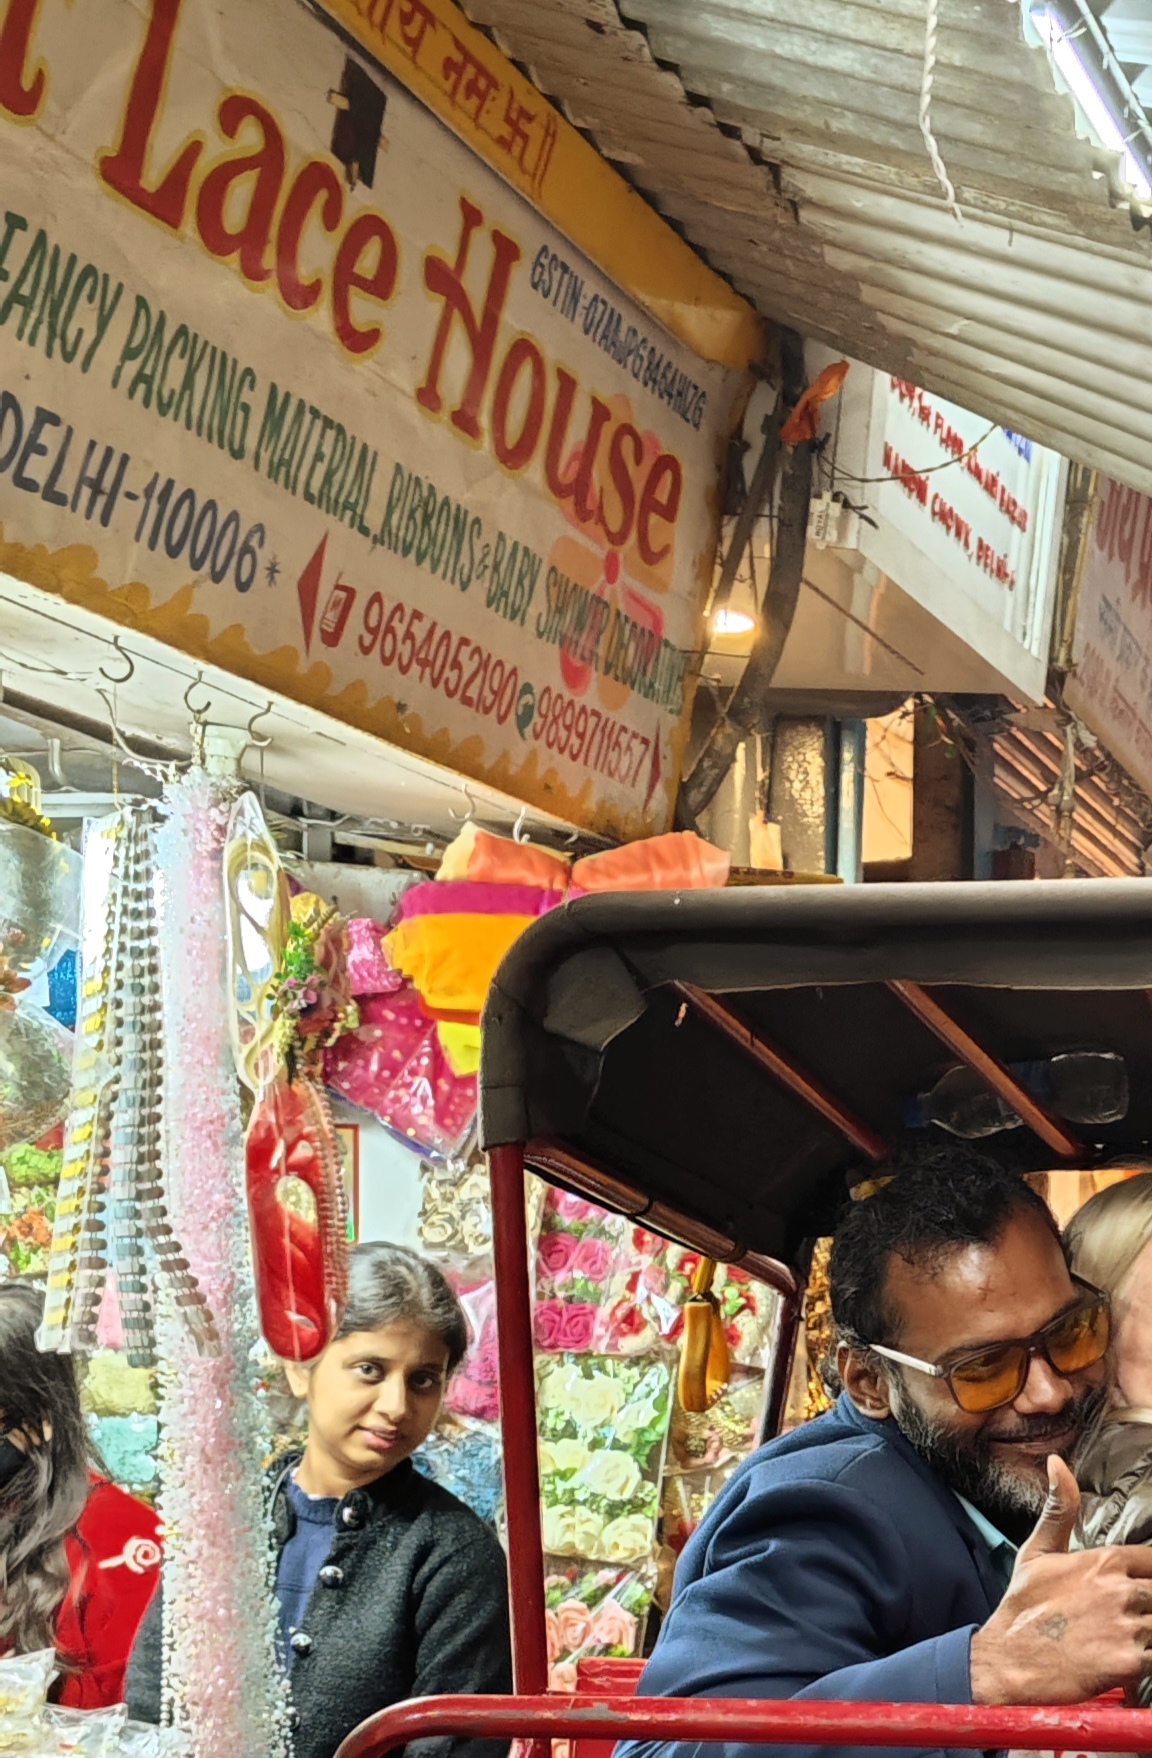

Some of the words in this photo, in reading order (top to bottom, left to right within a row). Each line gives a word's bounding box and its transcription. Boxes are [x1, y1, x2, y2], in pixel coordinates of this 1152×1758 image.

[100, 0, 399, 354] Lace
[416, 197, 683, 566] House
[111, 294, 257, 461] PACKING
[358, 591, 520, 725] 9654052190
[532, 686, 651, 788] 9899711557
